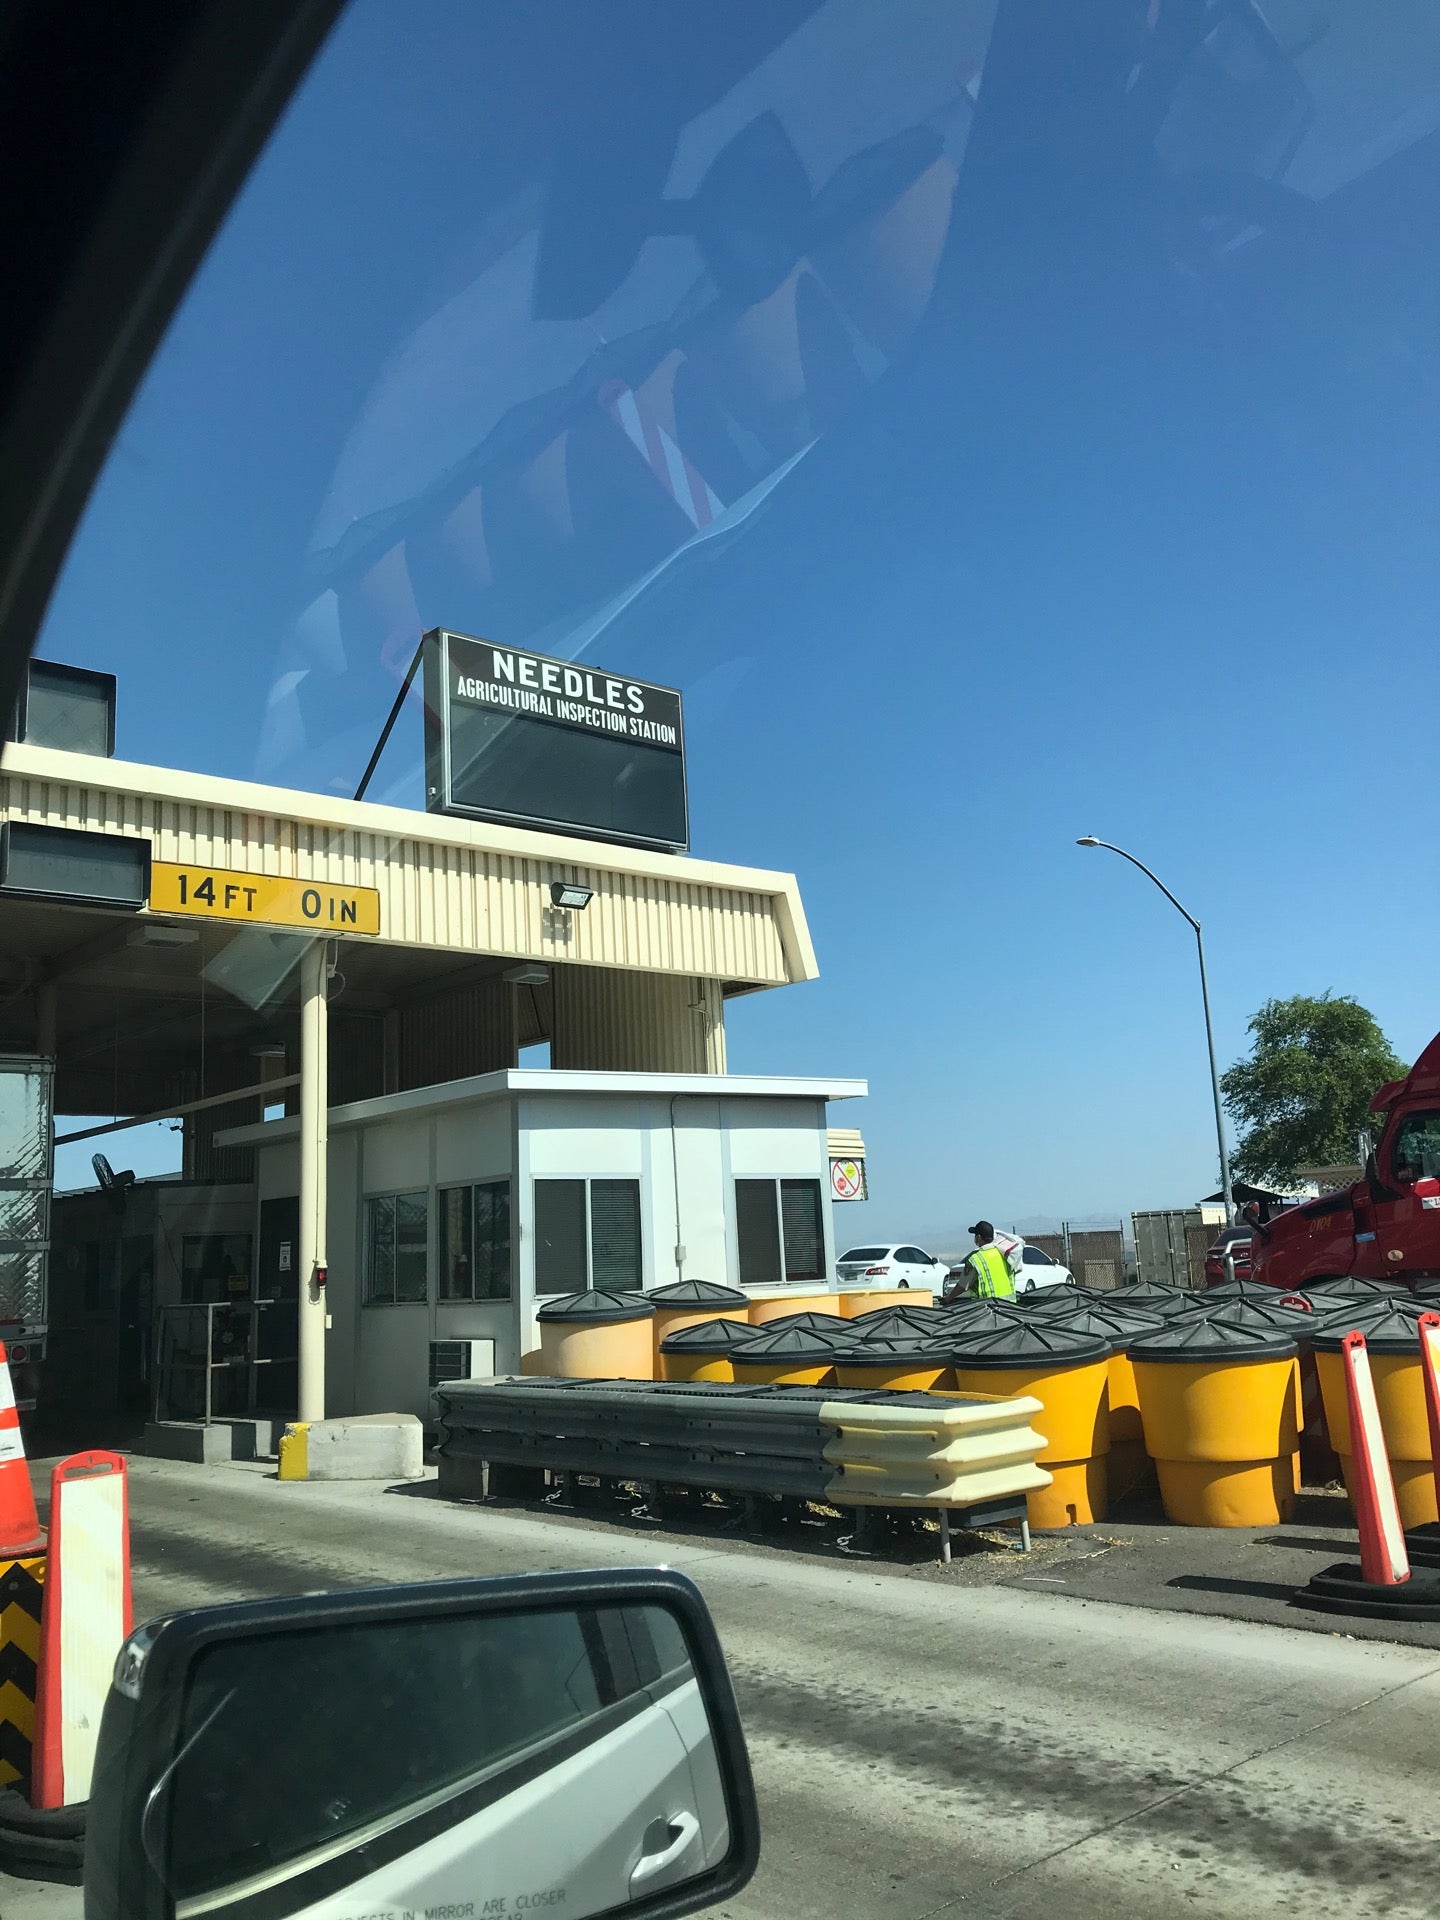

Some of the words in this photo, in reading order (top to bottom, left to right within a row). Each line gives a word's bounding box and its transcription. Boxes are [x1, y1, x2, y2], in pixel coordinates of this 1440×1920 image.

[457, 675, 554, 716] AGRICULTURAL
[556, 699, 628, 734] INSPECTION
[629, 717, 676, 745] STATION
[493, 650, 645, 714] NEEDLES
[425, 1902, 474, 1920] MIRROR
[483, 1897, 507, 1914] ARE
[515, 1889, 567, 1910] CLOSER
